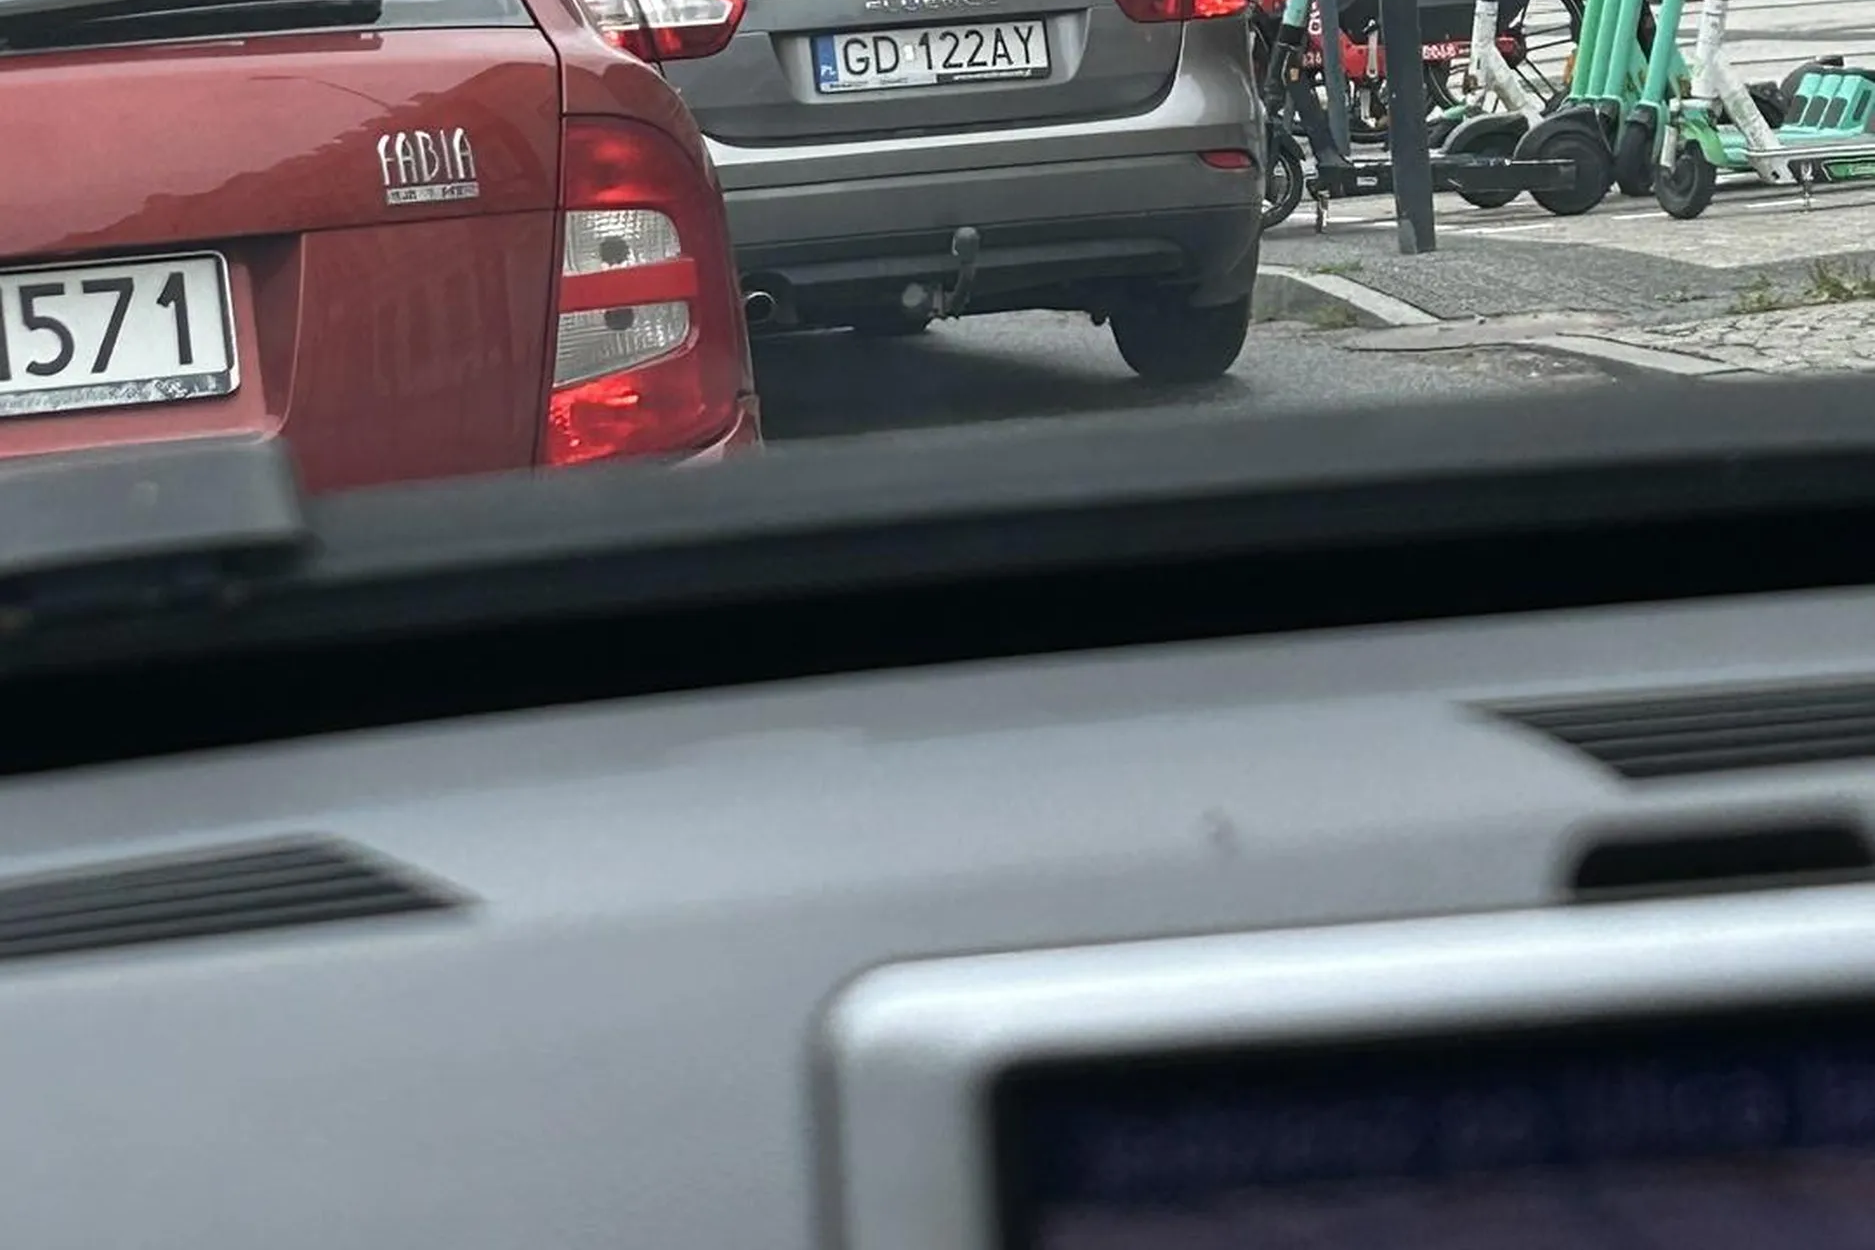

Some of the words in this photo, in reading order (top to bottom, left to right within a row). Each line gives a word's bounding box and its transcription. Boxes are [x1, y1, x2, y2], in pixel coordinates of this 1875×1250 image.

[842, 36, 899, 76] GD
[917, 24, 1034, 72] 122AY
[377, 128, 476, 185] FABIA
